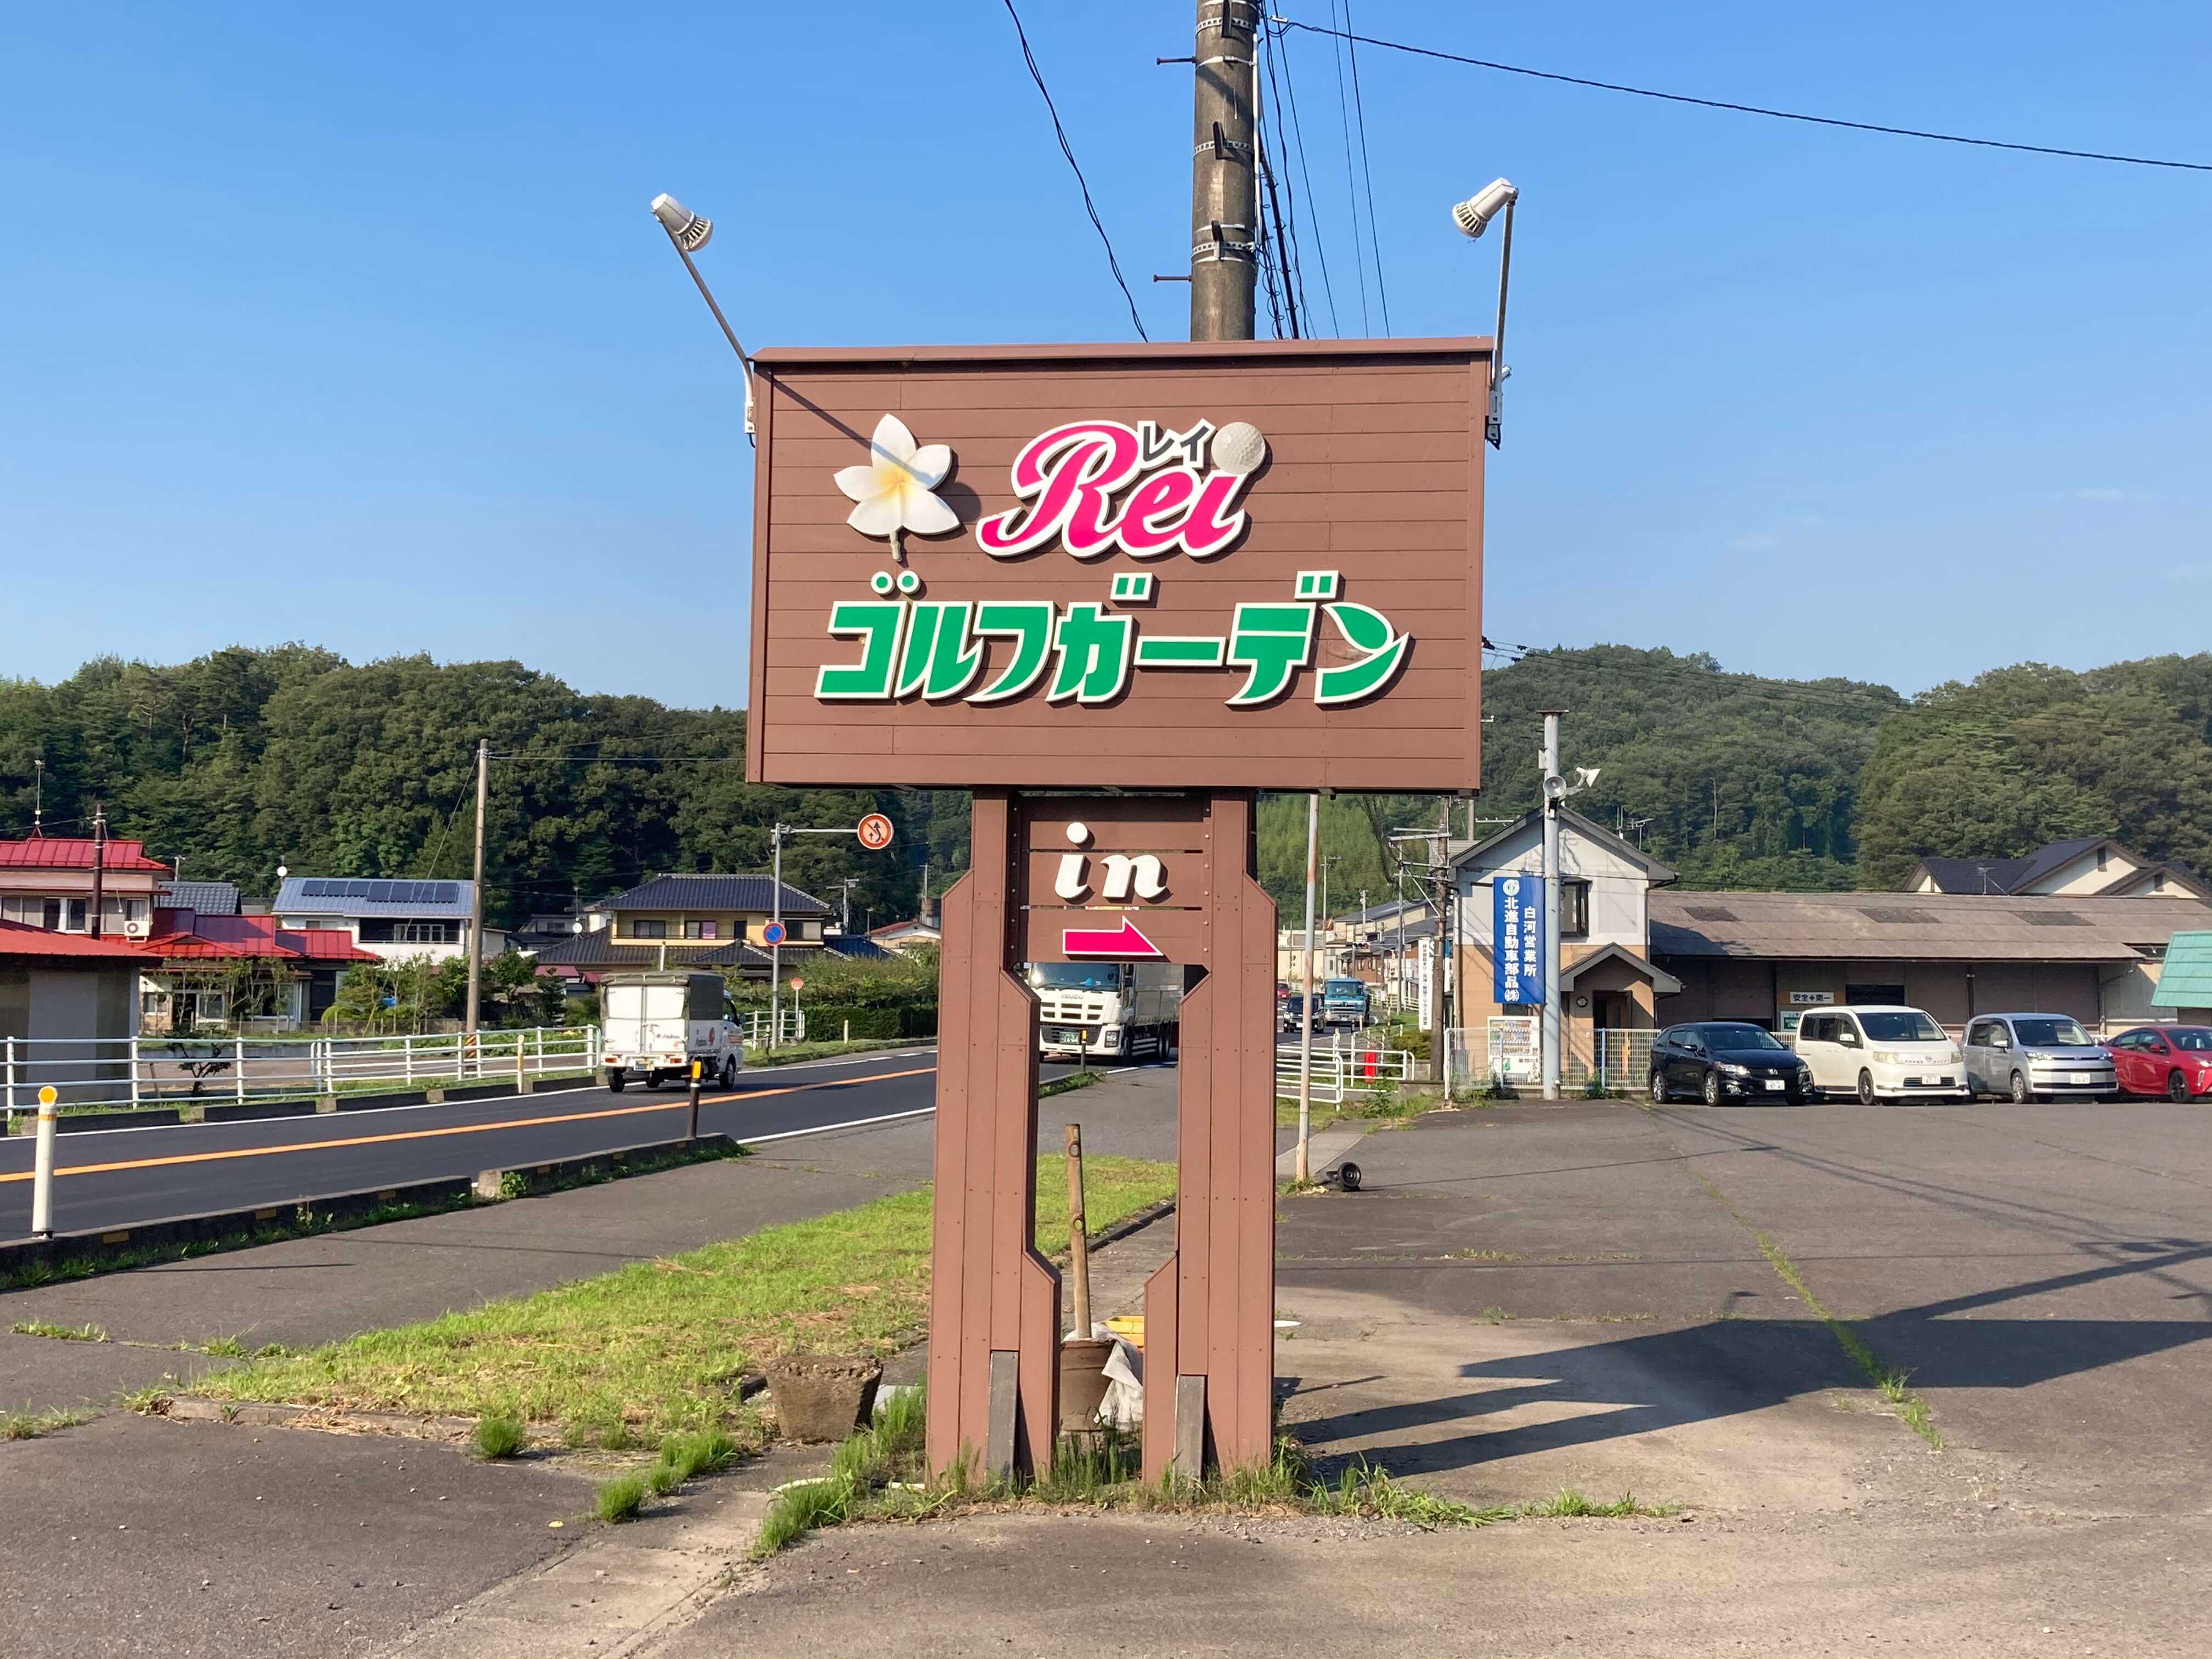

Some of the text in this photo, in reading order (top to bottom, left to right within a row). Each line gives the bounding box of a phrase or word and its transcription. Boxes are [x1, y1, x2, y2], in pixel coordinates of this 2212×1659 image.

[1140, 421, 1212, 465] レイ
[977, 420, 1266, 558] Rei
[813, 571, 1410, 704] ゴルフガーデン
[1054, 822, 1166, 899] in
[1523, 906, 1537, 977] 白河営業所
